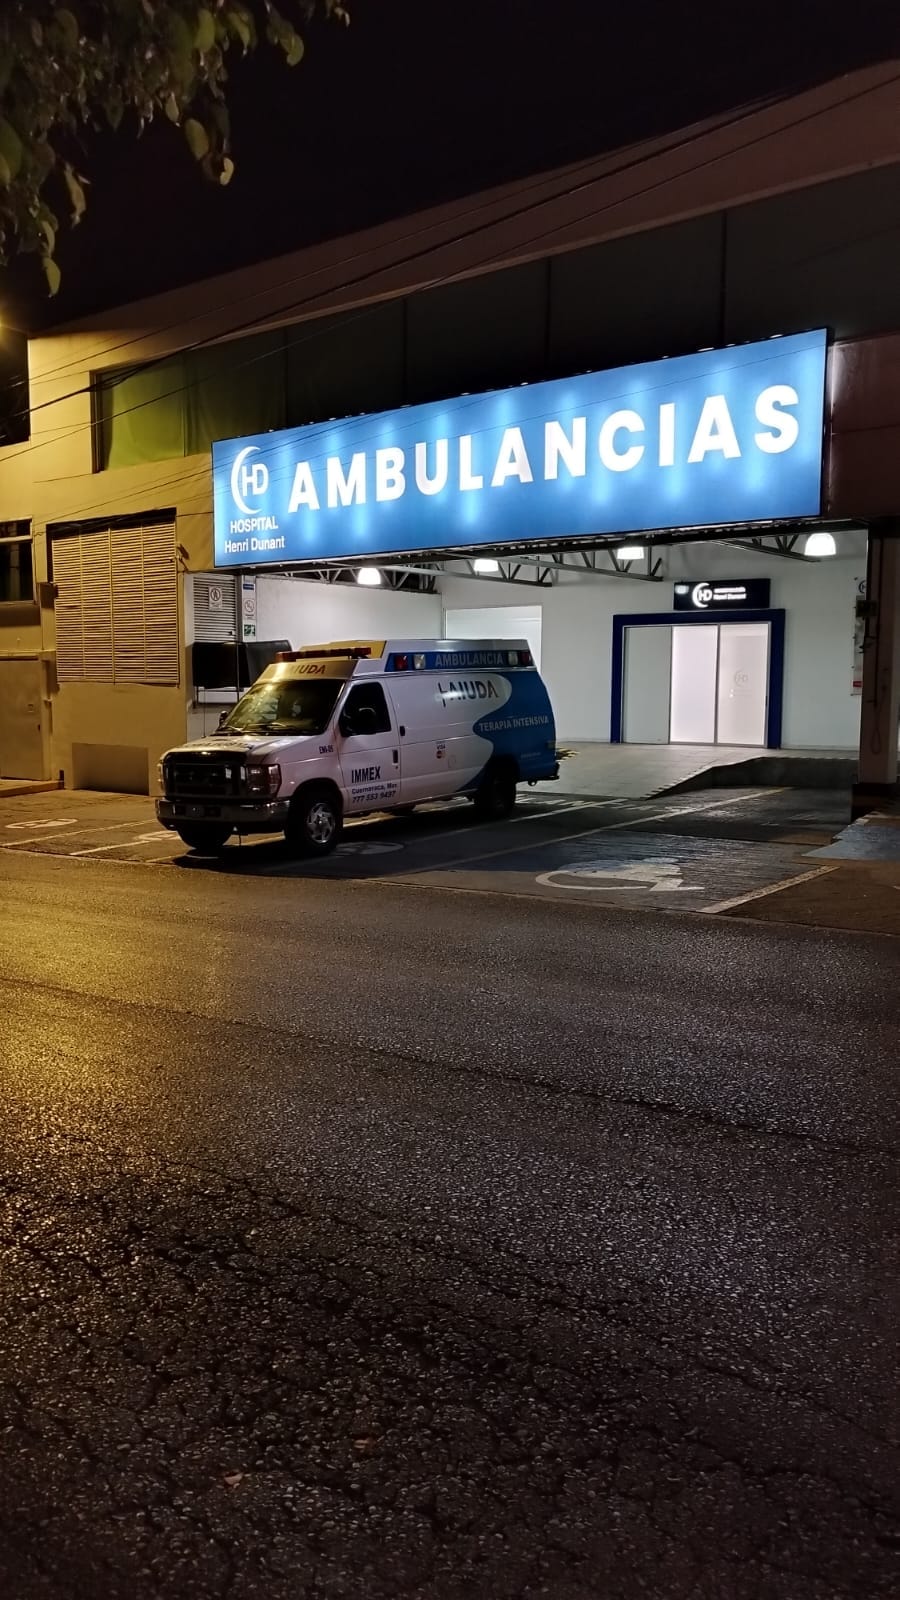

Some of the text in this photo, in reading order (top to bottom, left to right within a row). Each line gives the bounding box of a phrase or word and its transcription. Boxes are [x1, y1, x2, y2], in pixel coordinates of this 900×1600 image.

[288, 385, 799, 514] AMBULANCIAS
[230, 516, 278, 534] HOSPITAL
[224, 536, 285, 553] Henri Dunant
[435, 651, 504, 667] AMBULANCIA
[479, 715, 549, 732] TERAPIA INTENSIVA
[352, 766, 380, 783] IMMEX
[352, 795, 365, 803] 777
